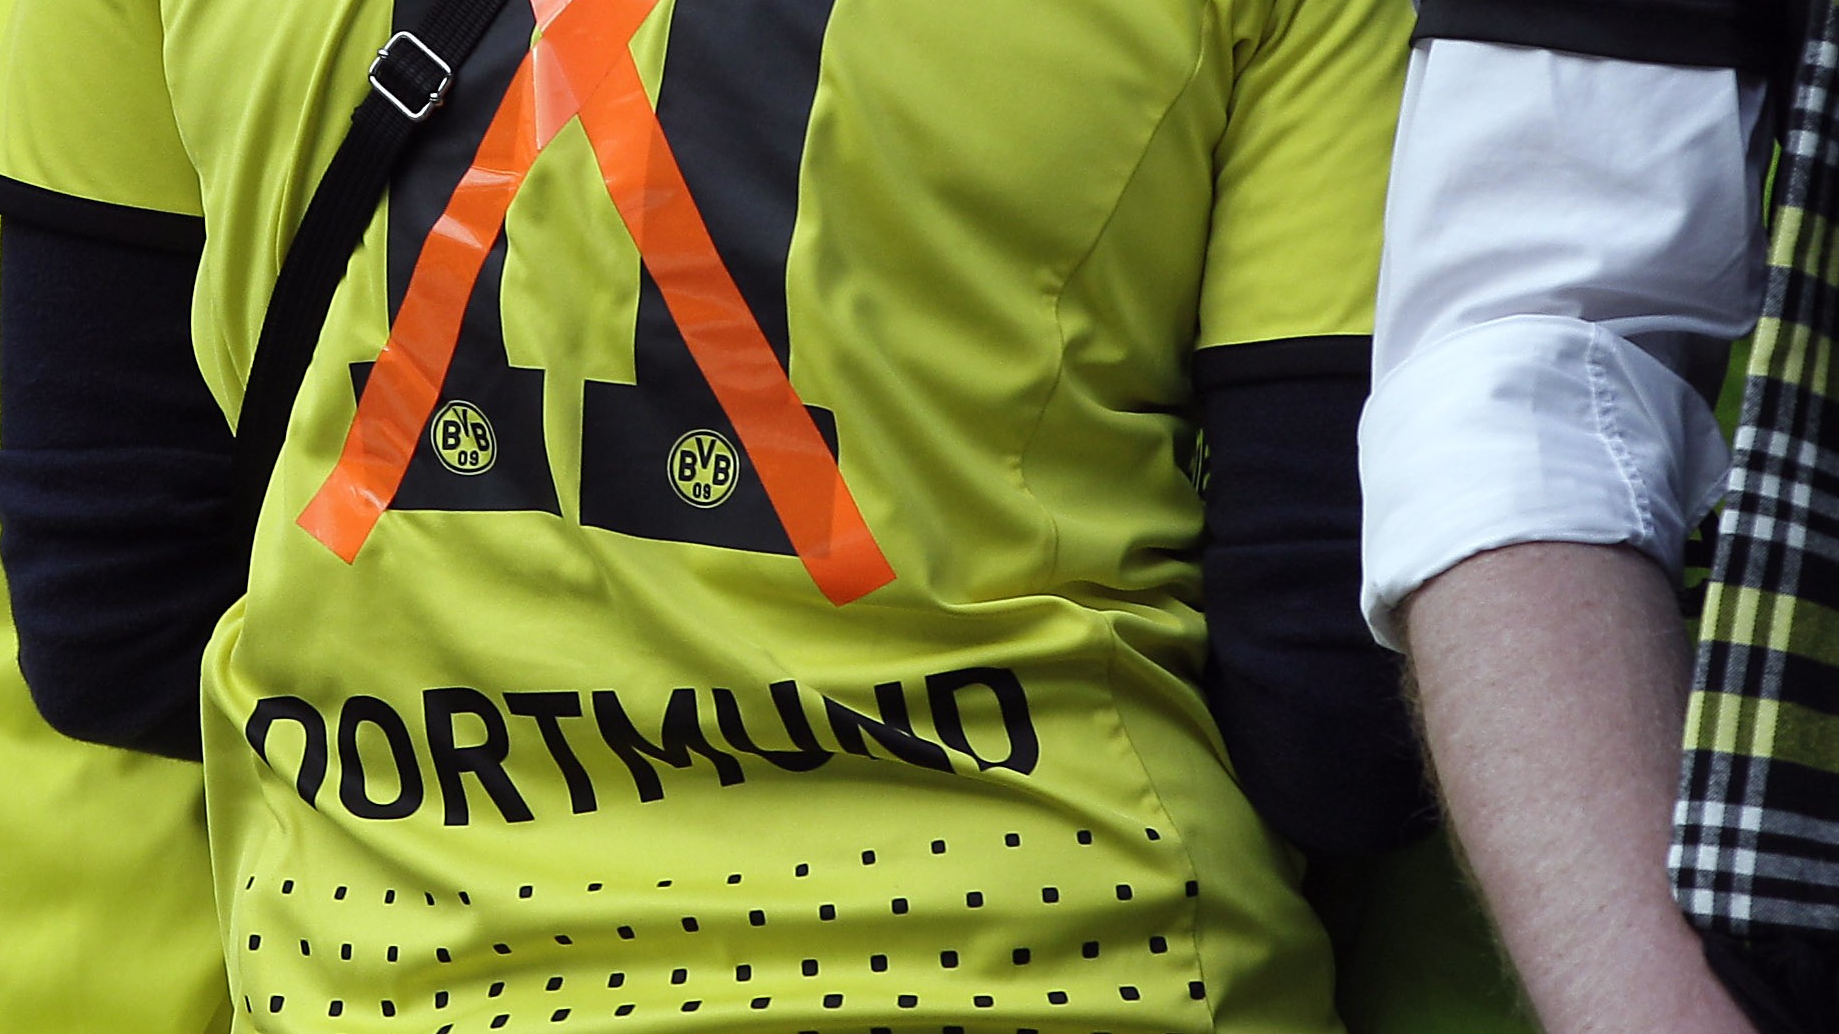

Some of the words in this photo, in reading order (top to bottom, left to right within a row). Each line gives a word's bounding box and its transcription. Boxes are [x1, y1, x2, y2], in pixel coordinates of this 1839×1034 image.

[442, 408, 490, 452] BVB
[457, 450, 479, 466] 09
[678, 437, 731, 486] BVB
[692, 482, 712, 499] 09
[245, 666, 1040, 826] DORTMUND
